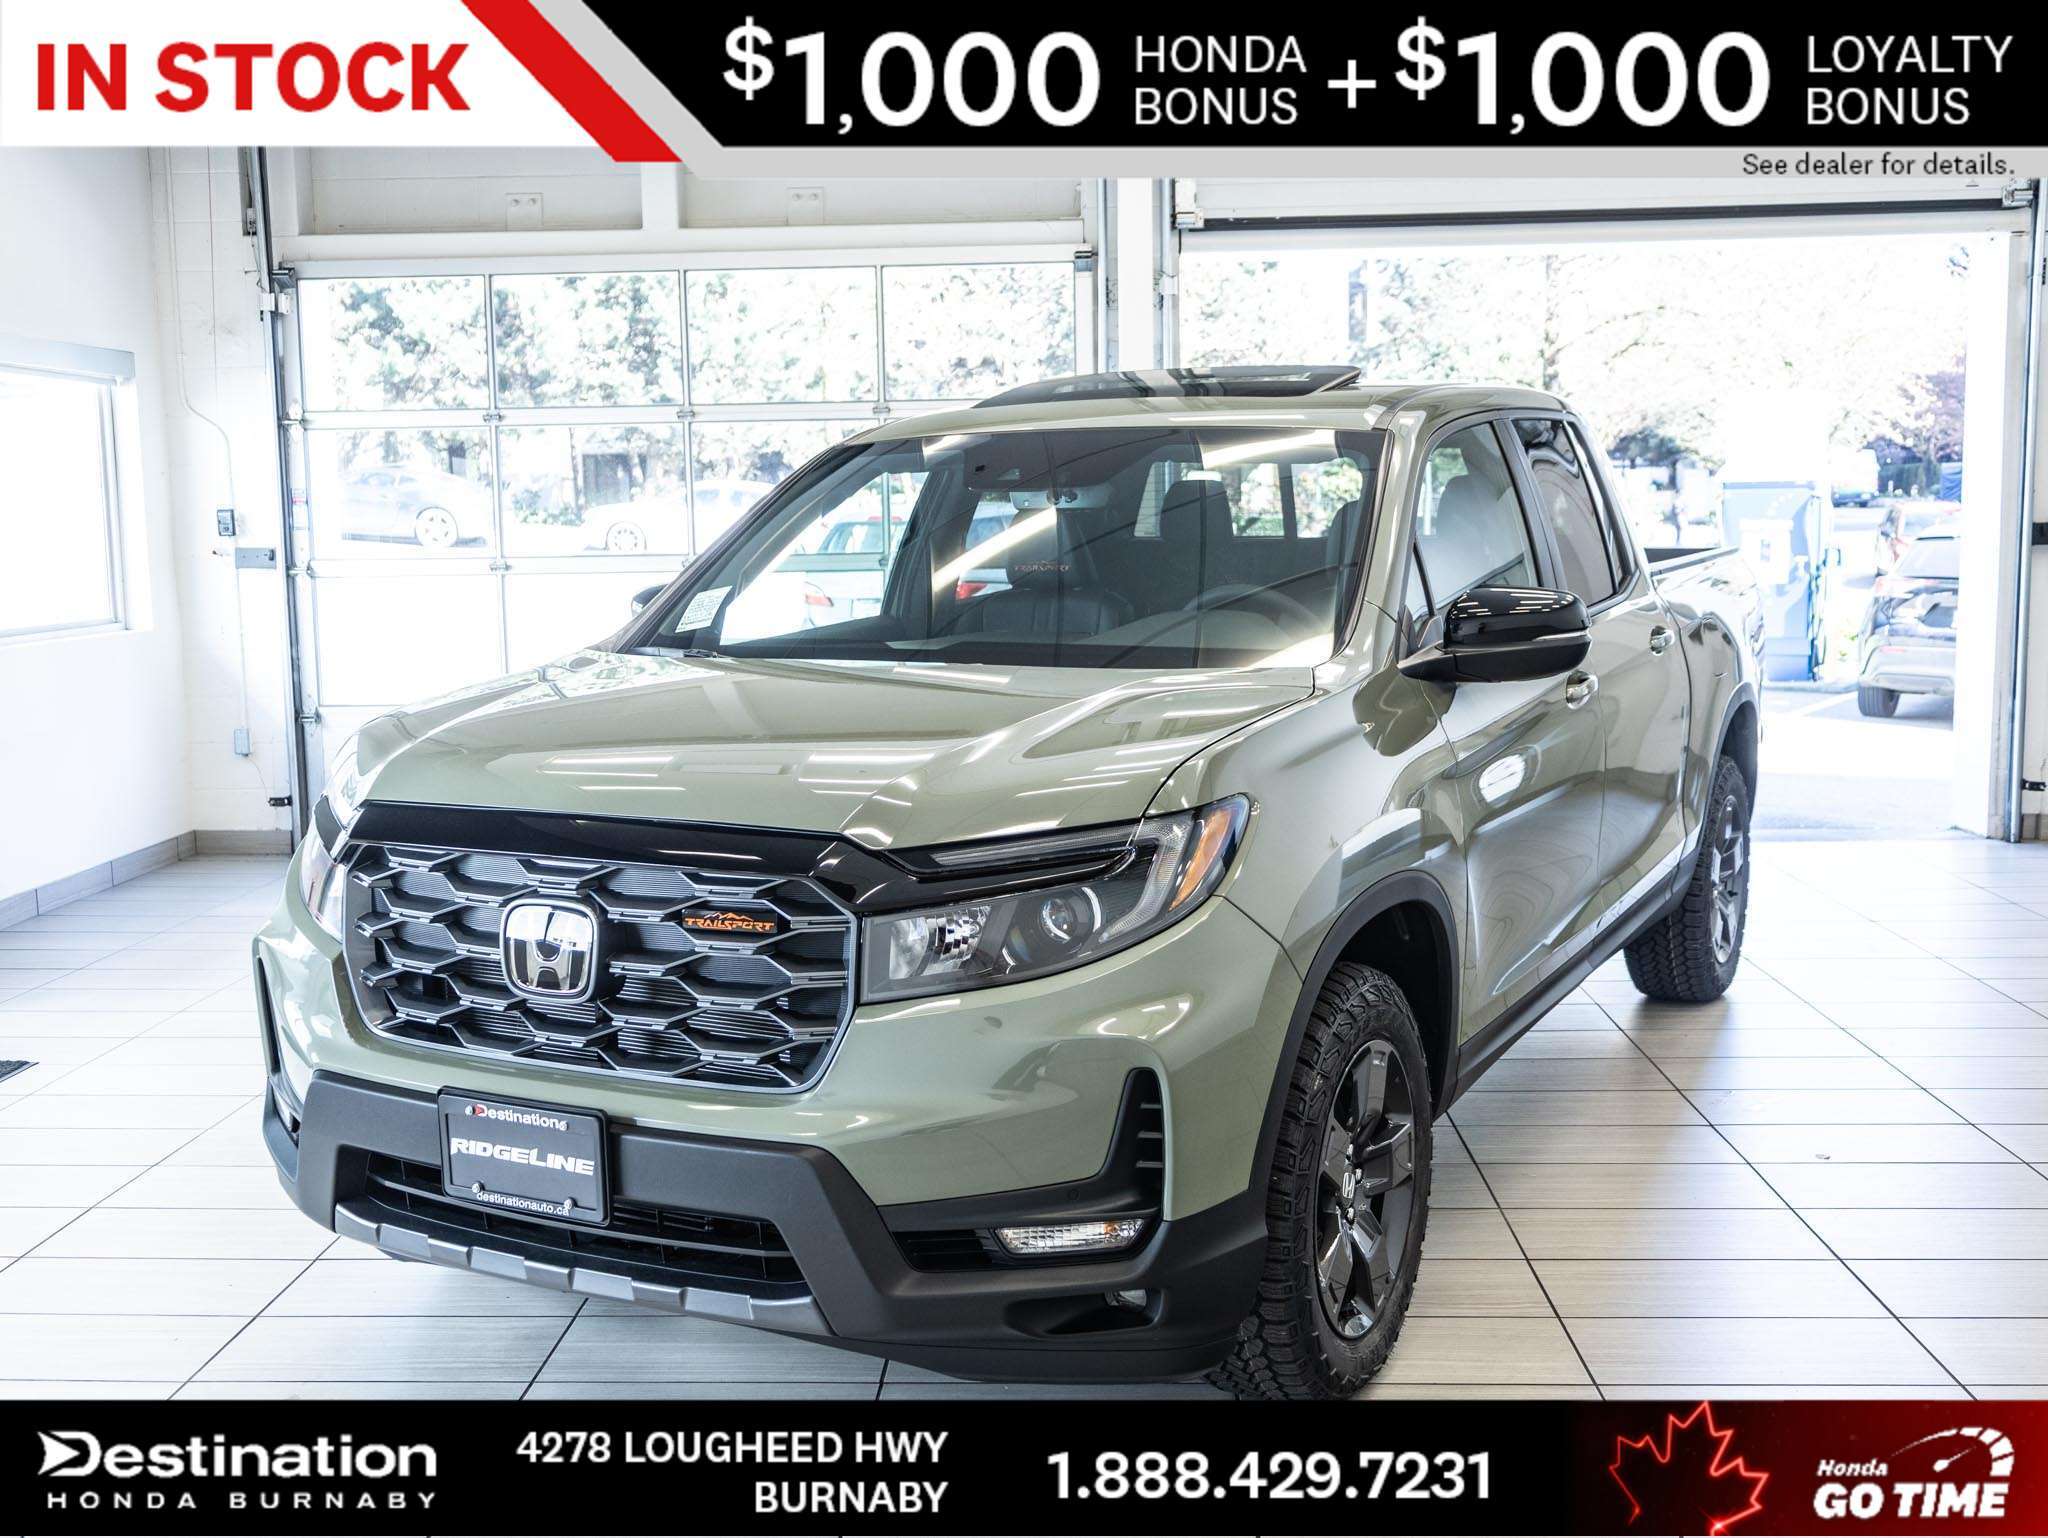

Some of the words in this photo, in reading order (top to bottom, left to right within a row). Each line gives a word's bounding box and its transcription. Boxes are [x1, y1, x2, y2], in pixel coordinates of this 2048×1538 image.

[685, 917, 775, 932] TRAILSPORT
[450, 1137, 595, 1177] RIDGELINE
[476, 1192, 570, 1217] destinationauto.ca
